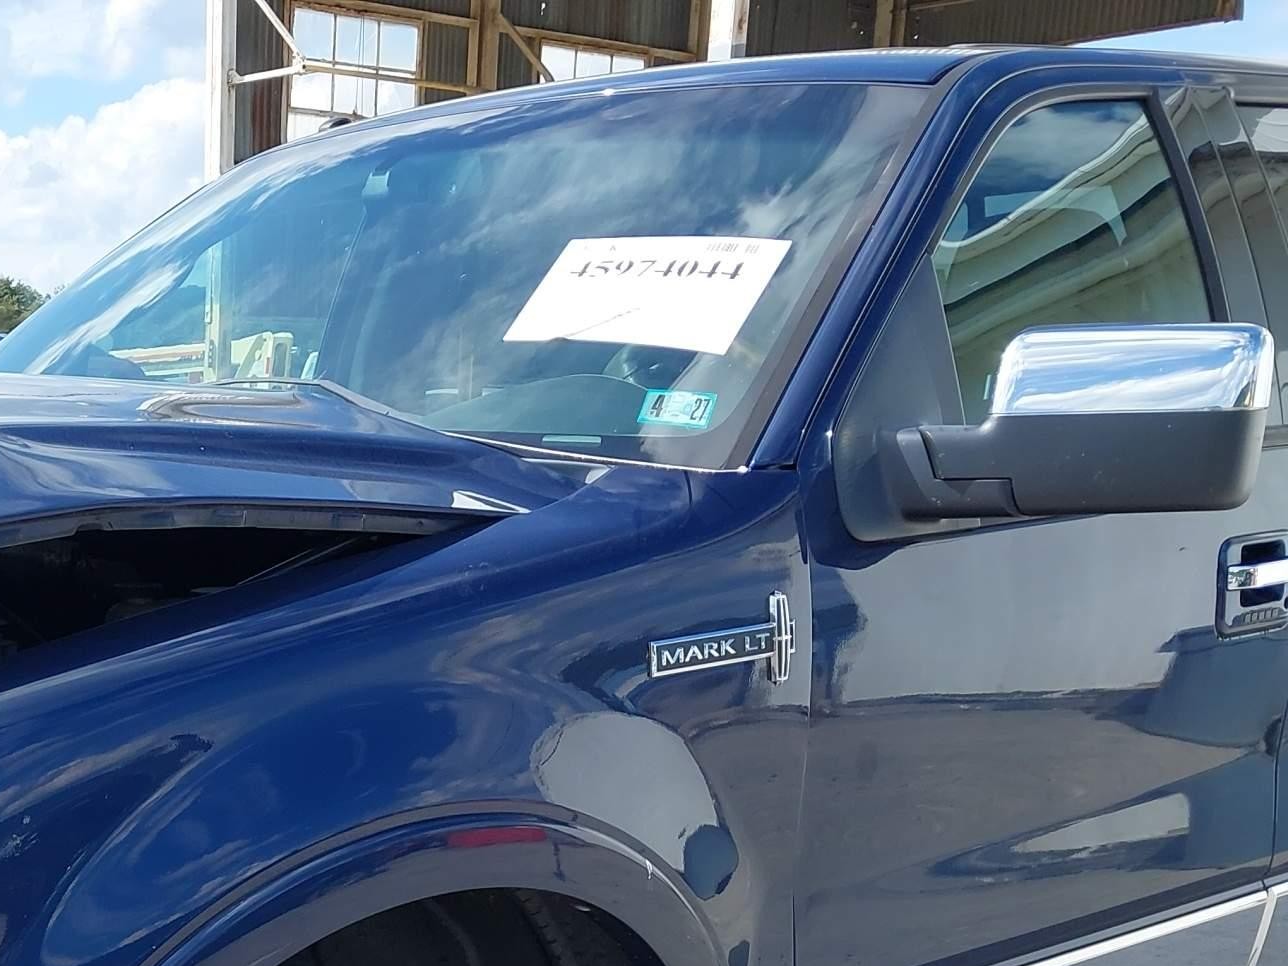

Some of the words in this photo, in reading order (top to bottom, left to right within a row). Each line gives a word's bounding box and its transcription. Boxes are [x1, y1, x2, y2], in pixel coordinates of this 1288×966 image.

[570, 259, 745, 279] 45974044
[650, 394, 666, 418] 4
[690, 397, 712, 421] 27
[661, 639, 737, 666] MARK
[743, 632, 771, 653] LT
